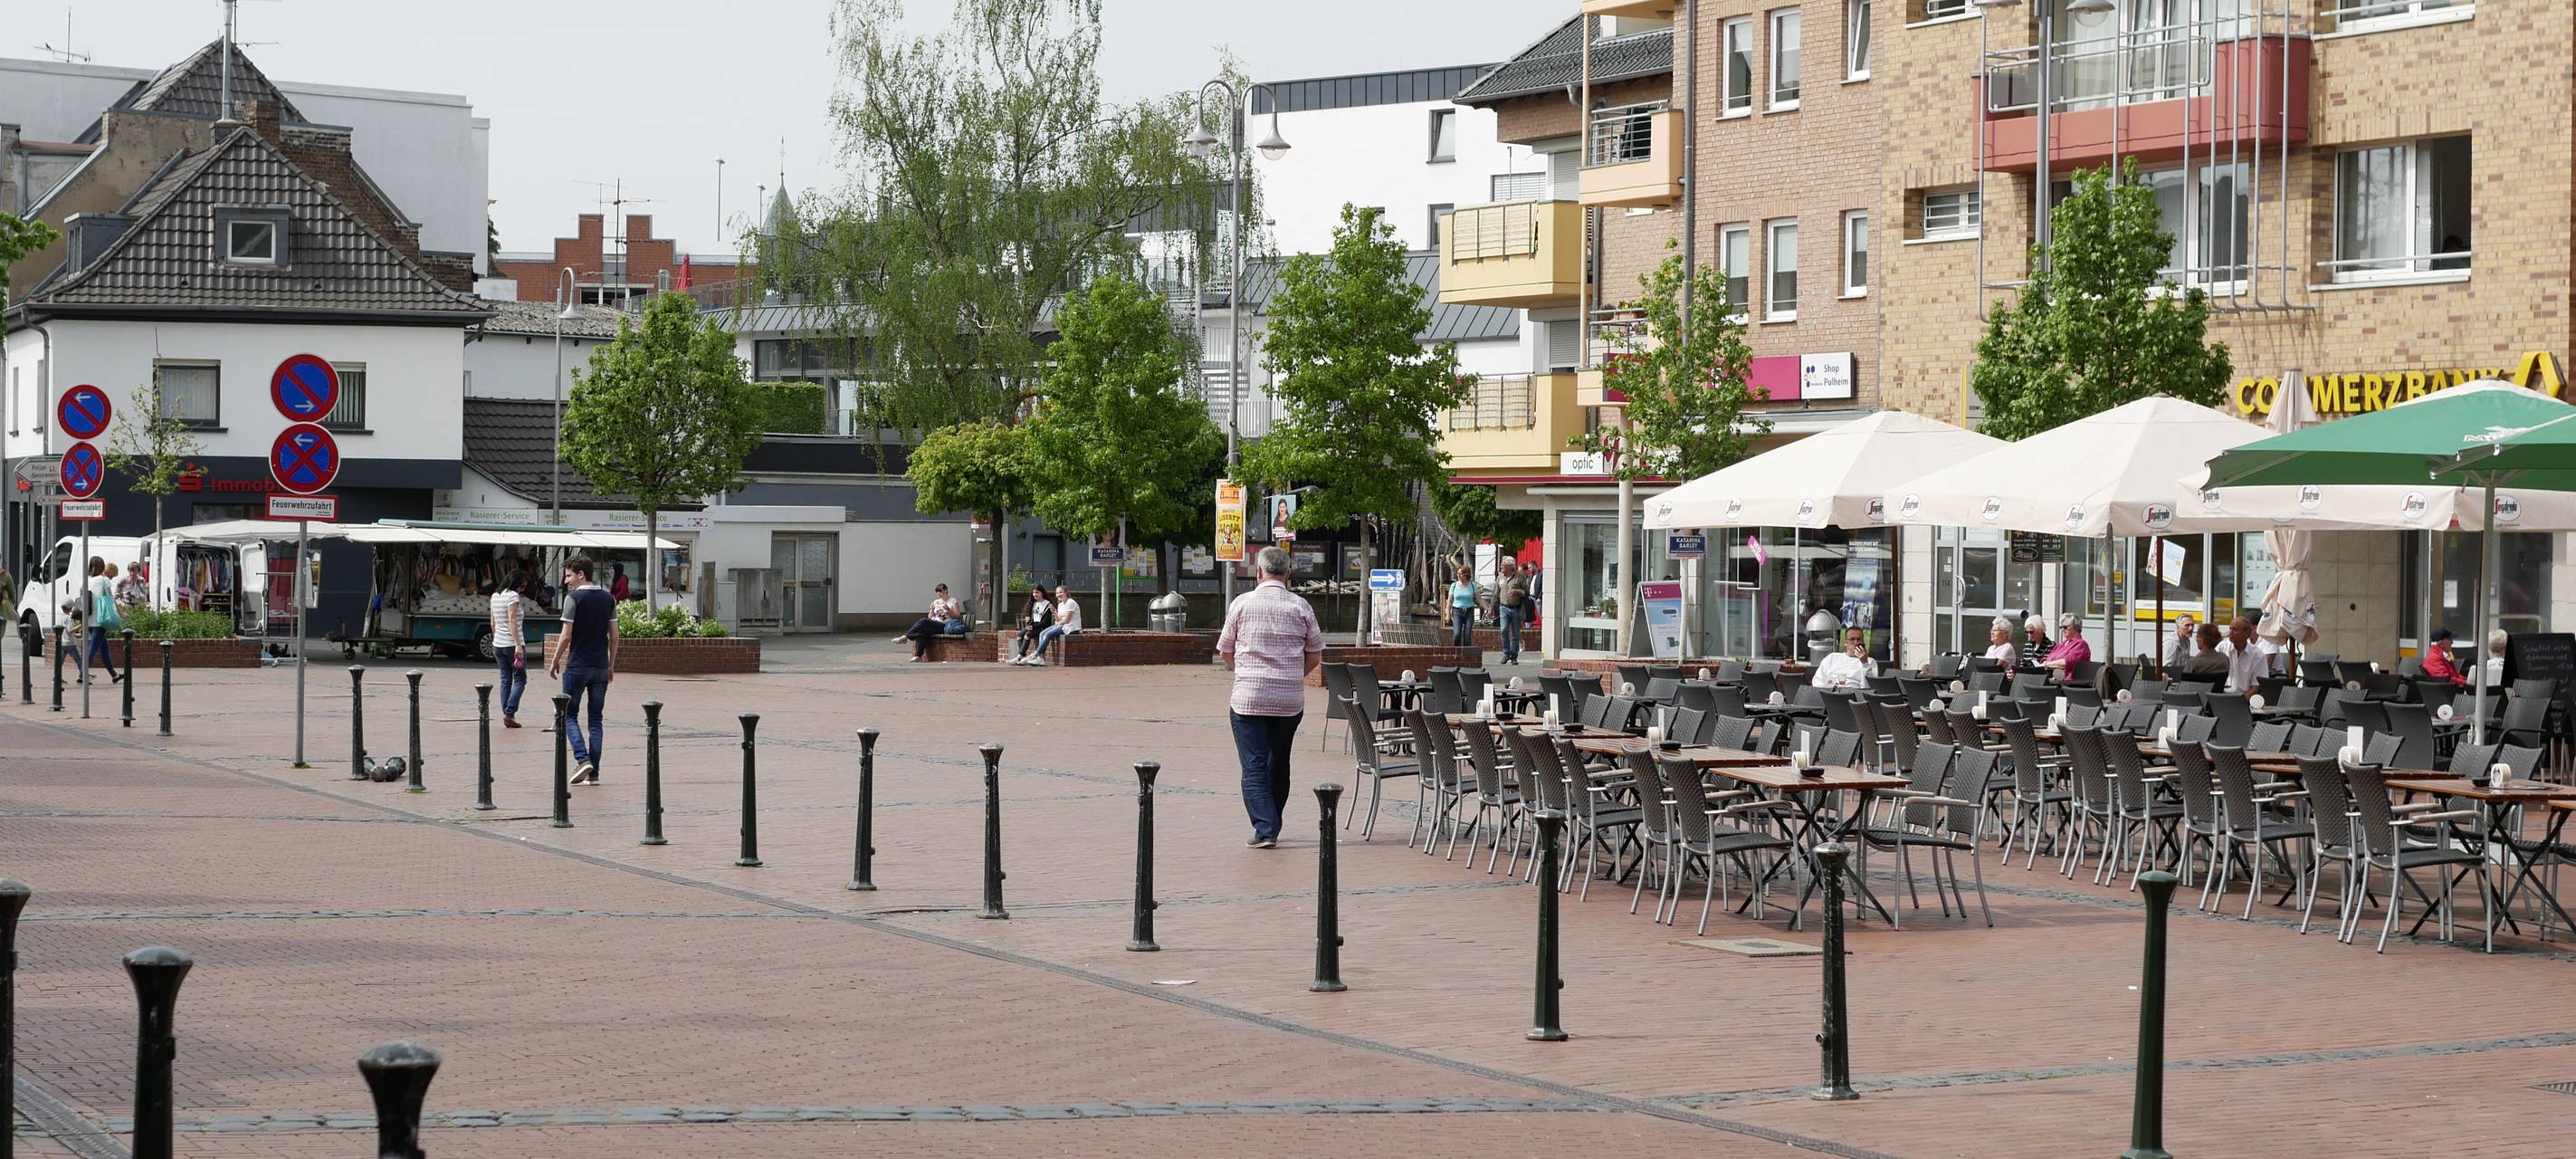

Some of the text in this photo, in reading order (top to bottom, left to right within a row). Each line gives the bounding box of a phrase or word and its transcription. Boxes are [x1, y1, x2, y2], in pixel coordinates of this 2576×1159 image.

[1824, 364, 1839, 375] Shop
[1824, 377, 1848, 387] Pulheim
[1572, 457, 1594, 472] optic
[64, 503, 101, 512] Feuerwehrzufahrt
[272, 499, 332, 511] Feuerwehrzufahrt
[470, 511, 530, 520] Rasierer-Service
[608, 513, 667, 522] Rasierer-Sice
